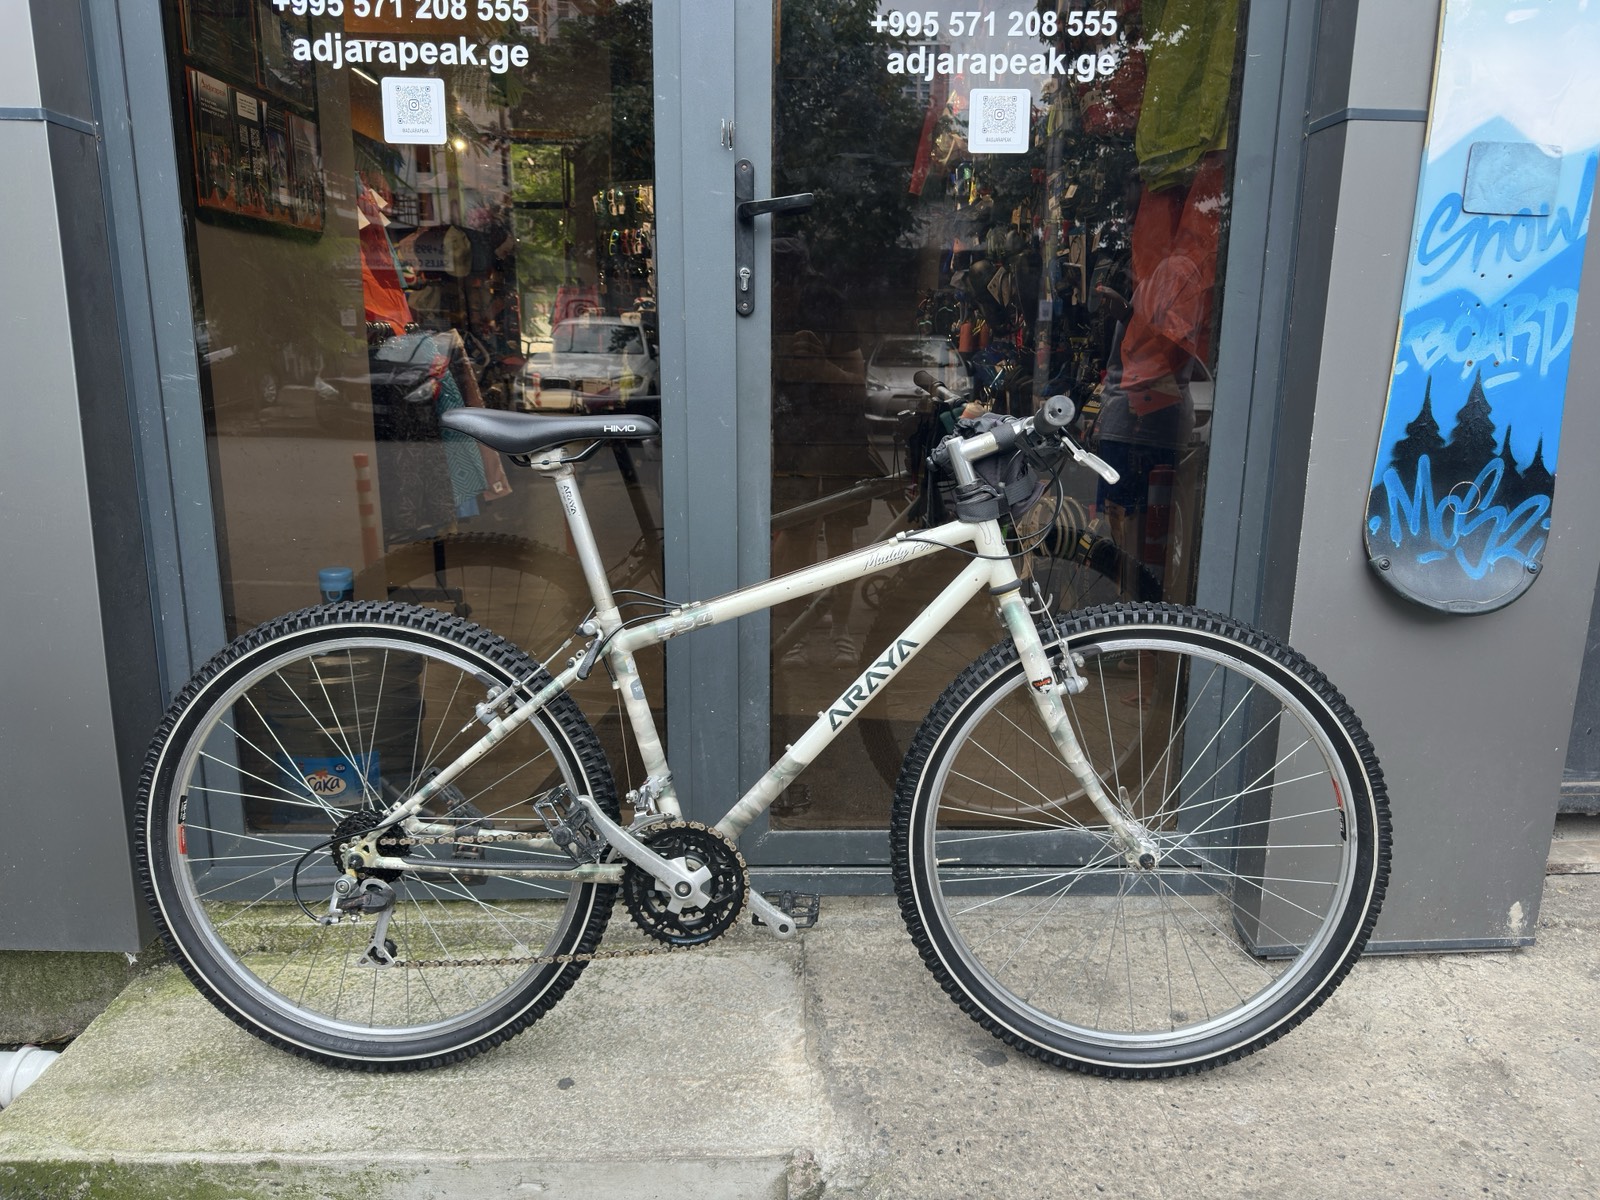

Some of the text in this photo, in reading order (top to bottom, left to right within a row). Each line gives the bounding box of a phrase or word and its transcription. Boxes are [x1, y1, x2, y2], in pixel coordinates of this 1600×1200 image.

[273, 0, 530, 22] +995 571 208 555
[870, 10, 1118, 37] +995 571 208 555
[292, 32, 530, 74] adjarapeak.ge
[886, 46, 1116, 83] adjarapeak.ge
[603, 424, 637, 433] HIMO
[563, 485, 577, 515] ARAYA
[828, 639, 920, 732] ARAYA
